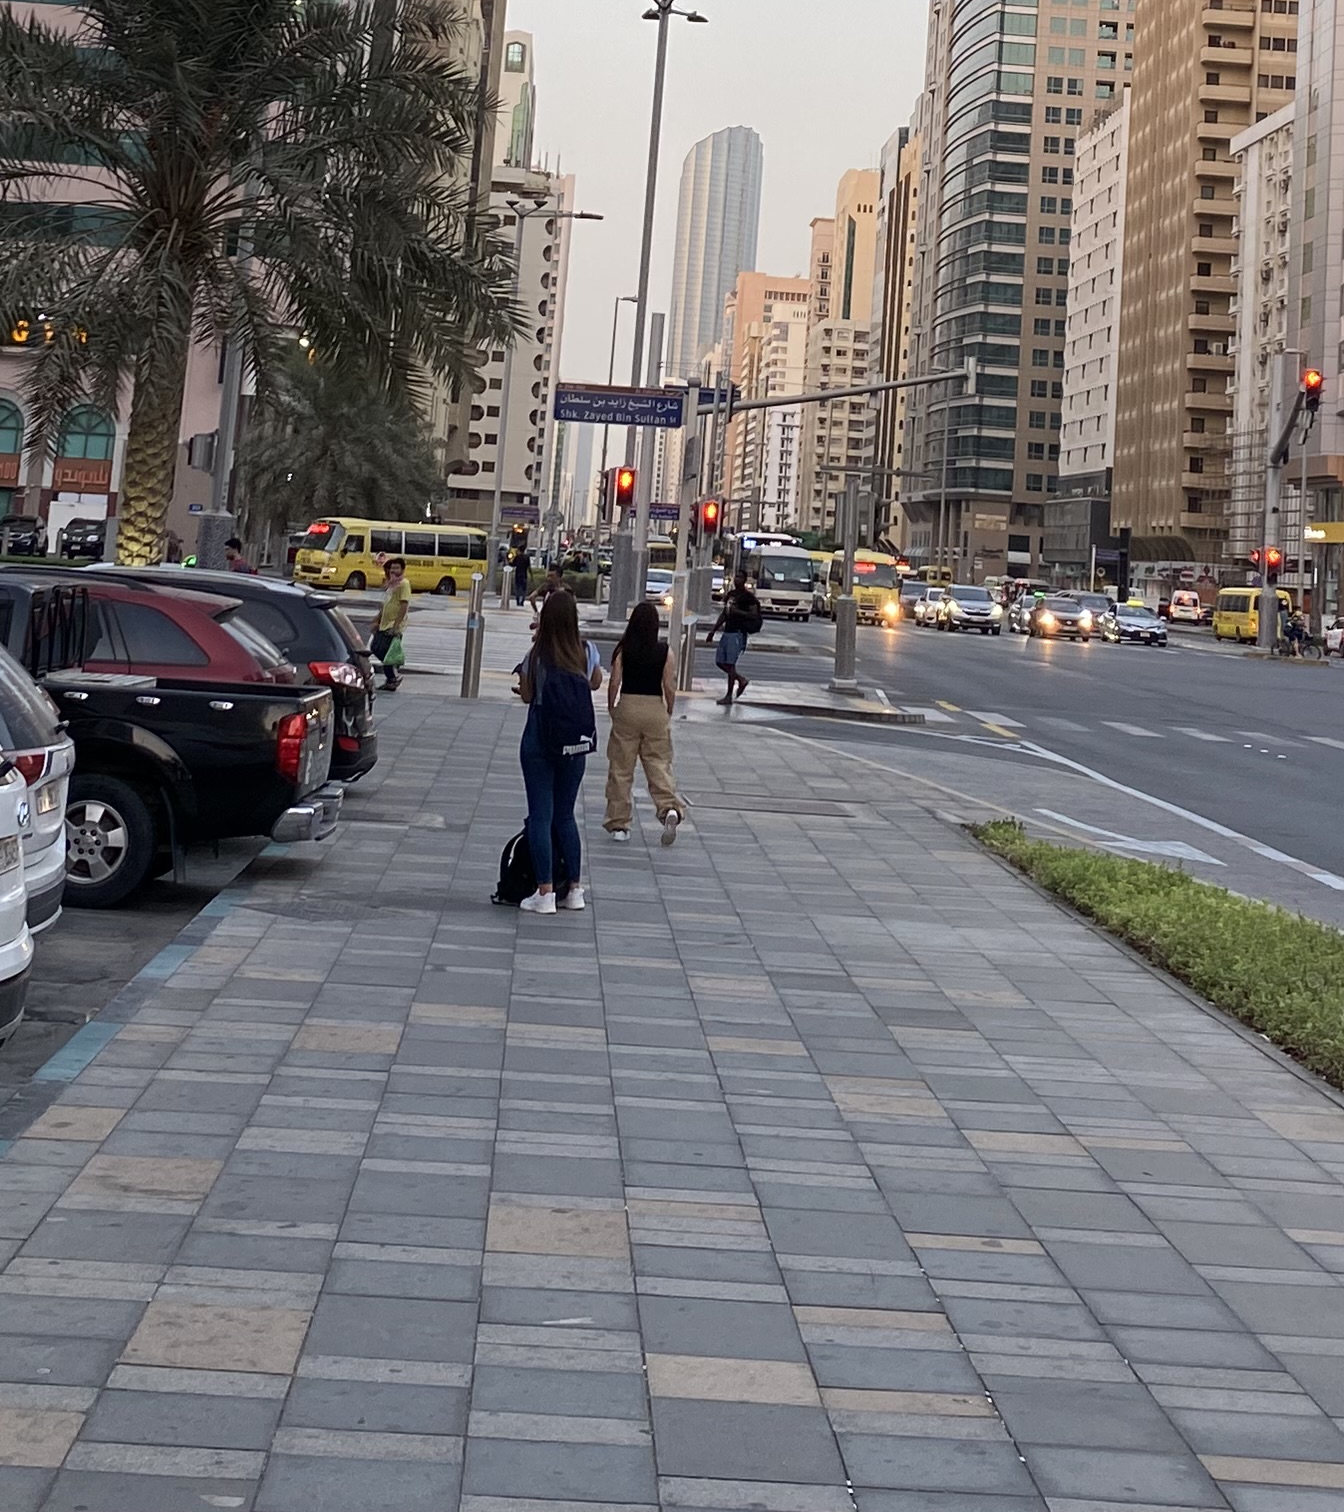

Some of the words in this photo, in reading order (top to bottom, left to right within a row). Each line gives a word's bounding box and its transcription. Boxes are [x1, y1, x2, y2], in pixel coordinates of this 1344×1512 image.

[583, 410, 614, 422] Zayed
[616, 413, 632, 423] Bin
[634, 414, 667, 425] Sultan
